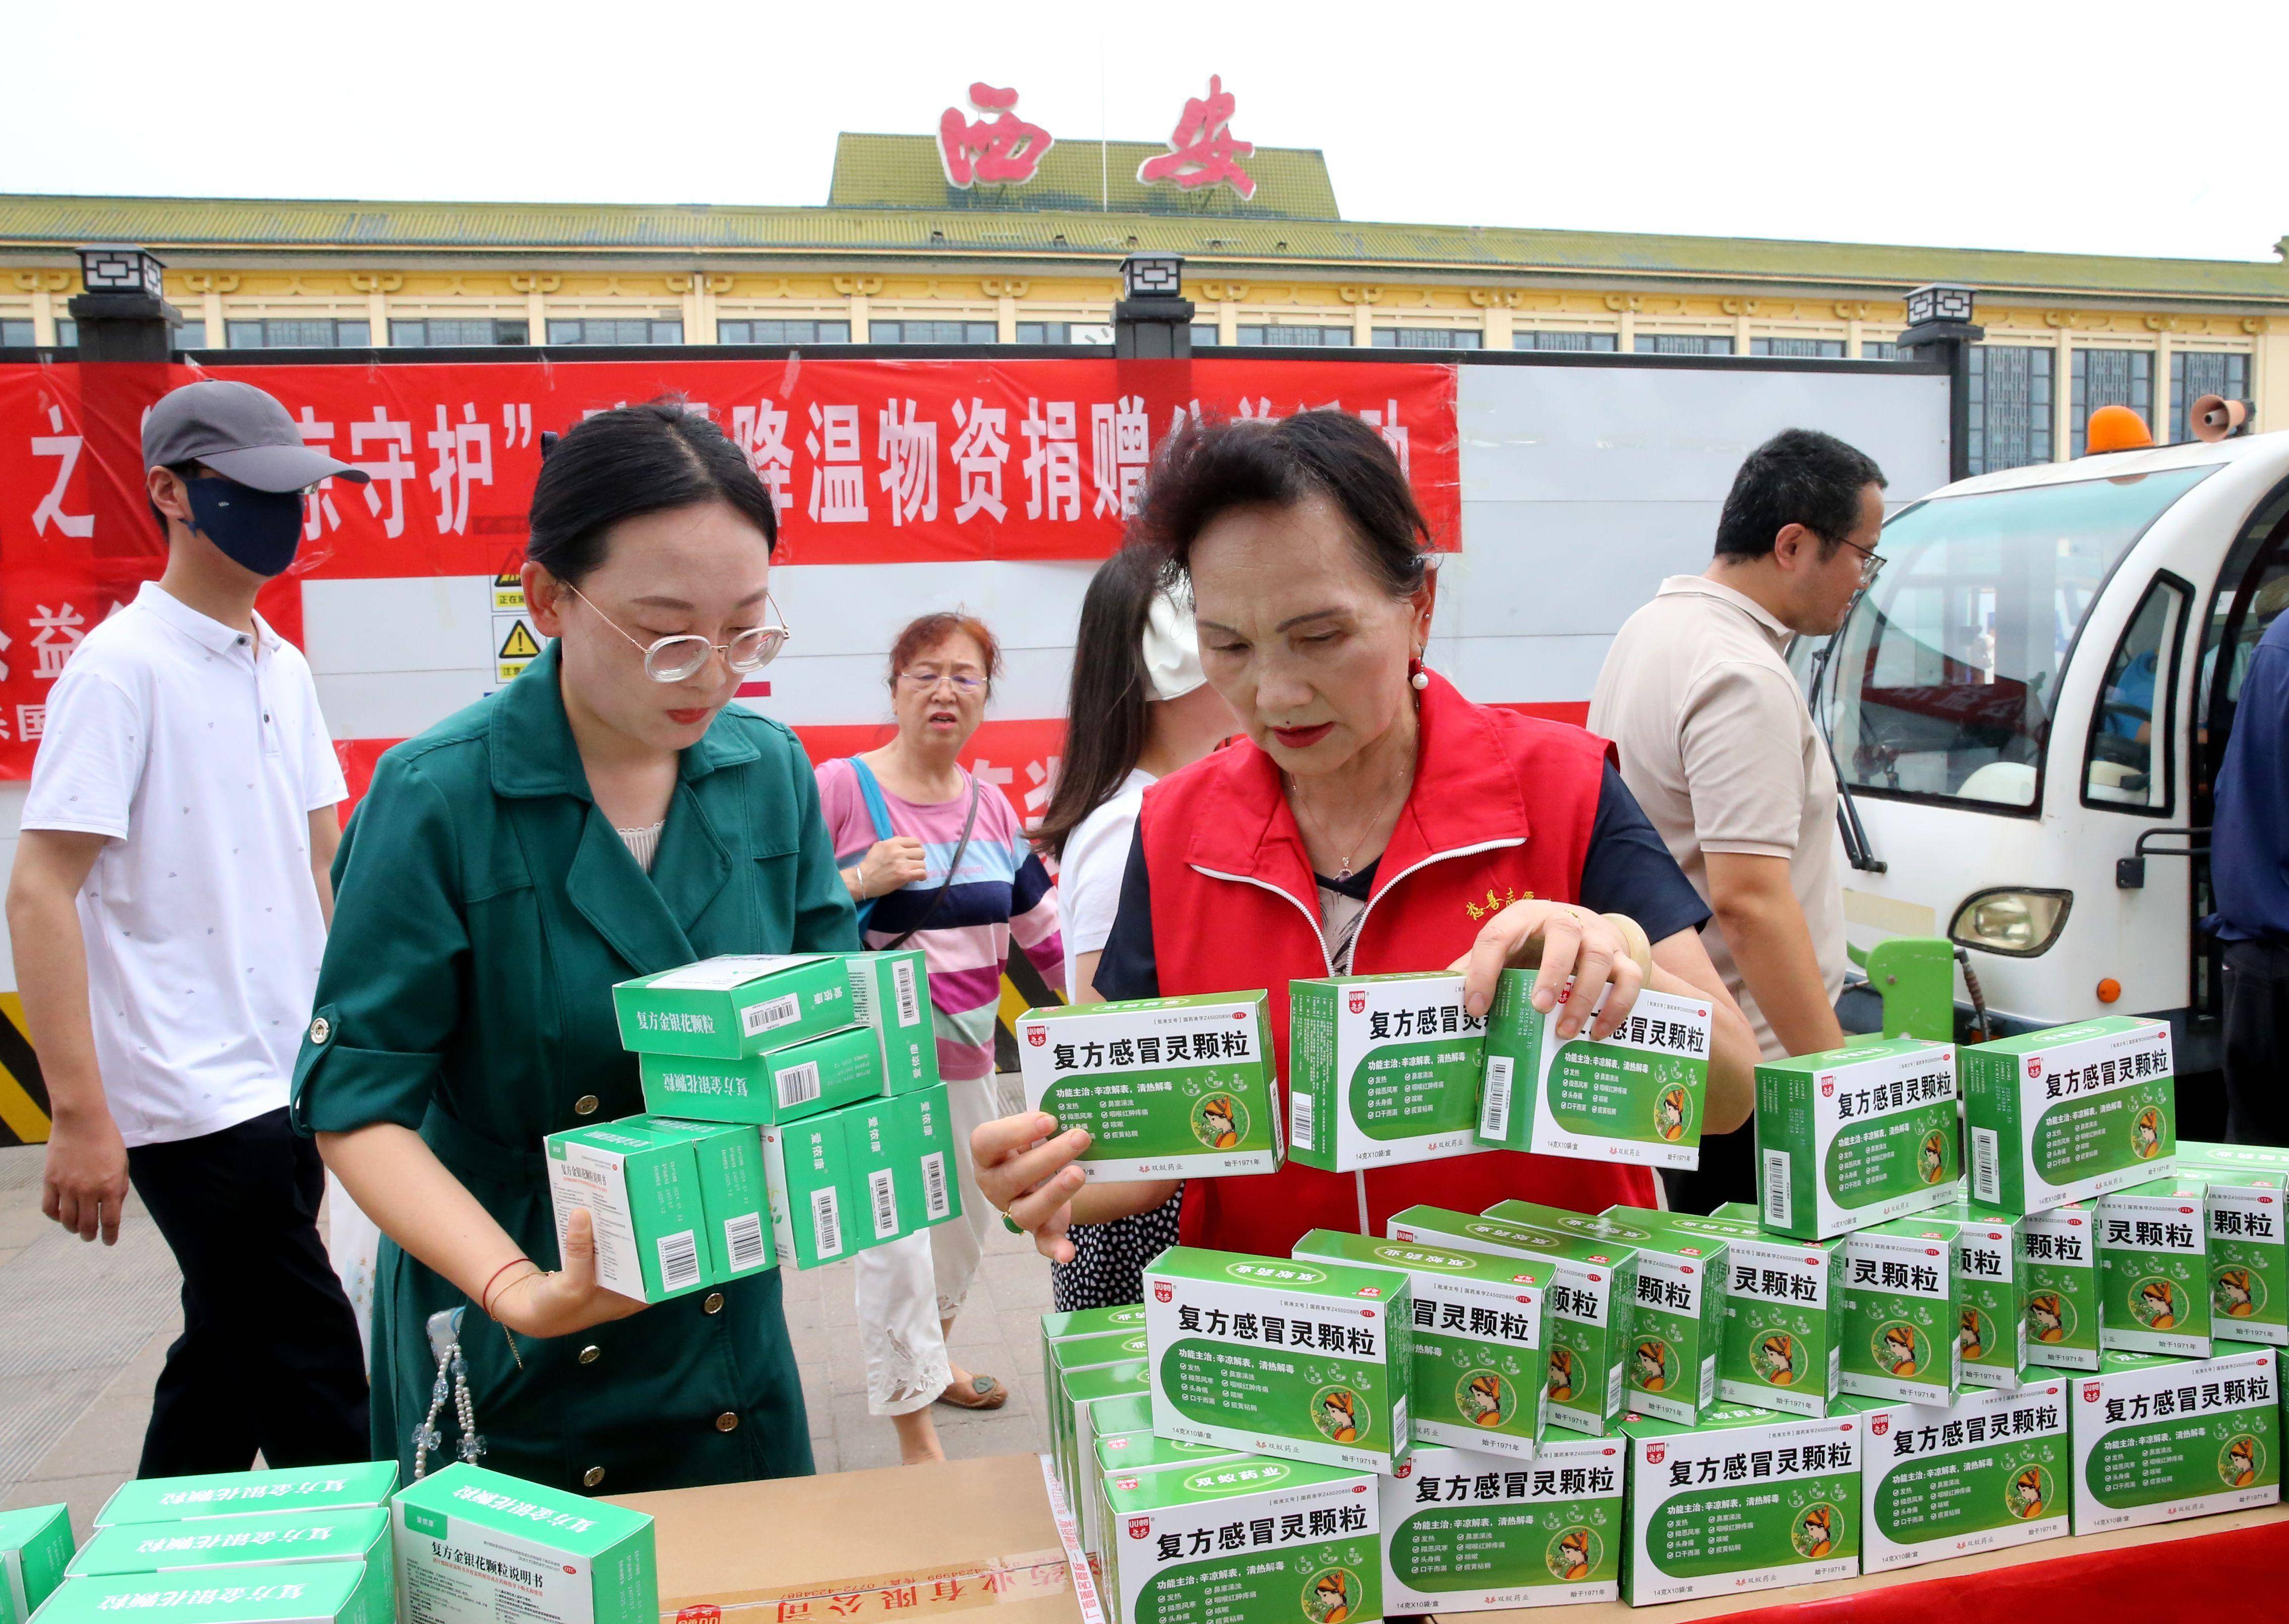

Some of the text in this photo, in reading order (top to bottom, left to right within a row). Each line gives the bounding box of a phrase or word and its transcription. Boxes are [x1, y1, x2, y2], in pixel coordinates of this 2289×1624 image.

[936, 74, 1256, 200] 西安
[636, 1011, 715, 1034] 复方金银花颗粒
[1369, 999, 1488, 1040] 复方感冒灵
[1580, 1003, 1705, 1054] 冒灵颗粒
[1052, 1029, 1250, 1070] 复方感冒灵颗粒
[2045, 1047, 2168, 1099] 复方感冒灵颗粒
[663, 1073, 749, 1097] 复方金银花颗粒
[1837, 1070, 1951, 1120] 复方感冒灵颗粒
[1065, 1102, 1079, 1110] 发热
[1224, 1158, 1261, 1168] 始于1971年
[1667, 1153, 1691, 1162] 始于1971年
[2148, 1165, 2170, 1175] 始于1971年
[1932, 1190, 1952, 1200] 始于1971年
[2214, 1209, 2273, 1238] 颗粒
[1474, 1226, 1550, 1246] 双蚁药业
[2100, 1218, 2194, 1249] 灵颗粒
[2026, 1233, 2082, 1261] 颗粒
[1384, 1248, 1466, 1268] 双蚁药业
[1235, 1264, 1317, 1283] 双蚁药业
[1587, 1273, 1601, 1282] OTC
[1680, 1265, 1693, 1274] OTC
[1846, 1256, 1938, 1293] 灵颗粒
[1637, 1274, 1692, 1311] 颗粒
[1728, 1263, 1817, 1303] 灵颗粒
[1516, 1295, 1530, 1303] OTC
[1360, 1309, 1374, 1317] OTC
[1413, 1297, 1529, 1342] 冒灵颗粒
[1177, 1303, 1375, 1357] 复方感冒灵颗粒
[2235, 1328, 2274, 1338] 始于1971年
[2159, 1341, 2197, 1350] 始于1971年
[2047, 1353, 2084, 1363] 始于1971年
[1187, 1364, 1201, 1373] 发热
[1965, 1371, 2002, 1382] 始于1971年
[1189, 1384, 1208, 1394] 头身痛
[1900, 1388, 1936, 1400] 始于1971年
[1776, 1397, 1812, 1410] 始于1971年
[2104, 1375, 2270, 1424] 复方感冒灵颗粒
[1648, 1402, 1683, 1417] 始于1971年
[1708, 1407, 1771, 1422] 蚁药业
[1555, 1411, 1589, 1428] 始于1971年
[1893, 1403, 2058, 1456] 复方感冒灵颗粒
[1481, 1439, 1520, 1452] 始于1971年
[1341, 1454, 1378, 1466] 始于1971年
[1669, 1441, 1852, 1487] 复方感冒灵颗粒
[1195, 1466, 1282, 1488] 双蚁药业
[1416, 1466, 1615, 1502] 复方感冒灵颗粒
[159, 1478, 351, 1505] 复方金银花颗粒
[1352, 1485, 1366, 1493] OTC
[2239, 1493, 2269, 1503] 始于1971年
[453, 1484, 600, 1534] 复方金银花颗粒
[1156, 1502, 1368, 1561] 复方感冒灵颗粒
[2028, 1524, 2057, 1536] 始于1971年
[135, 1527, 335, 1553] 复方金银花颗粒
[431, 1541, 544, 1588] 复方金银花颗粒说明书
[1814, 1565, 1847, 1576] 始于1971年
[96, 1583, 312, 1610] 复方金银花颗粒
[1167, 1592, 1181, 1602] 发热
[1570, 1589, 1605, 1598] 始于1971年
[1168, 1612, 1190, 1622] 头身痛
